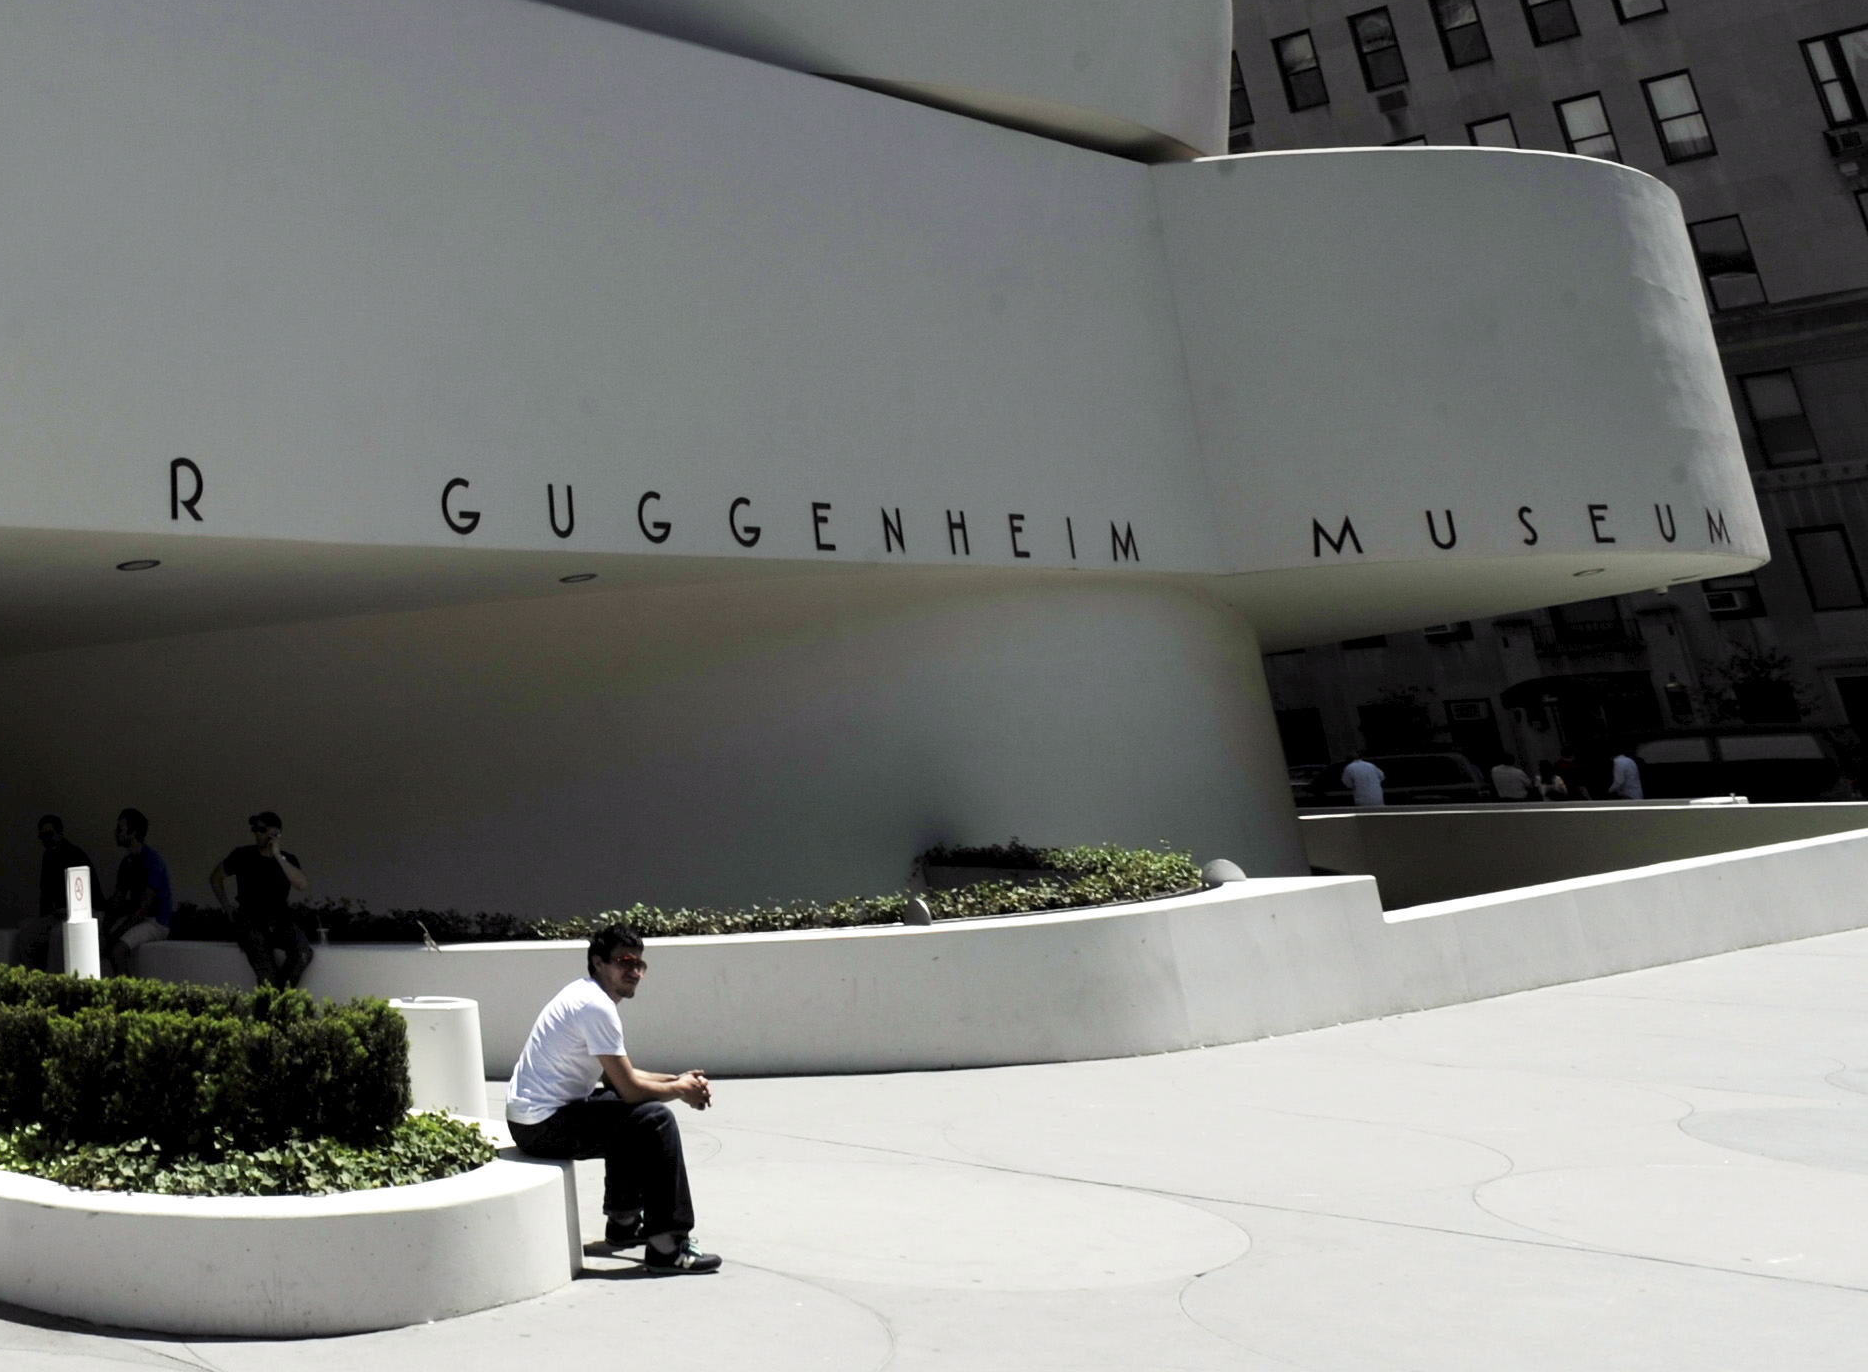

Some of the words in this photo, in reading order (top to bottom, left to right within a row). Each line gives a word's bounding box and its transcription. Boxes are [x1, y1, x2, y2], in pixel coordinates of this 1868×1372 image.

[169, 456, 205, 523] R
[440, 476, 1141, 563] GUGGENHEIM
[1311, 502, 1732, 559] MUSEUM
